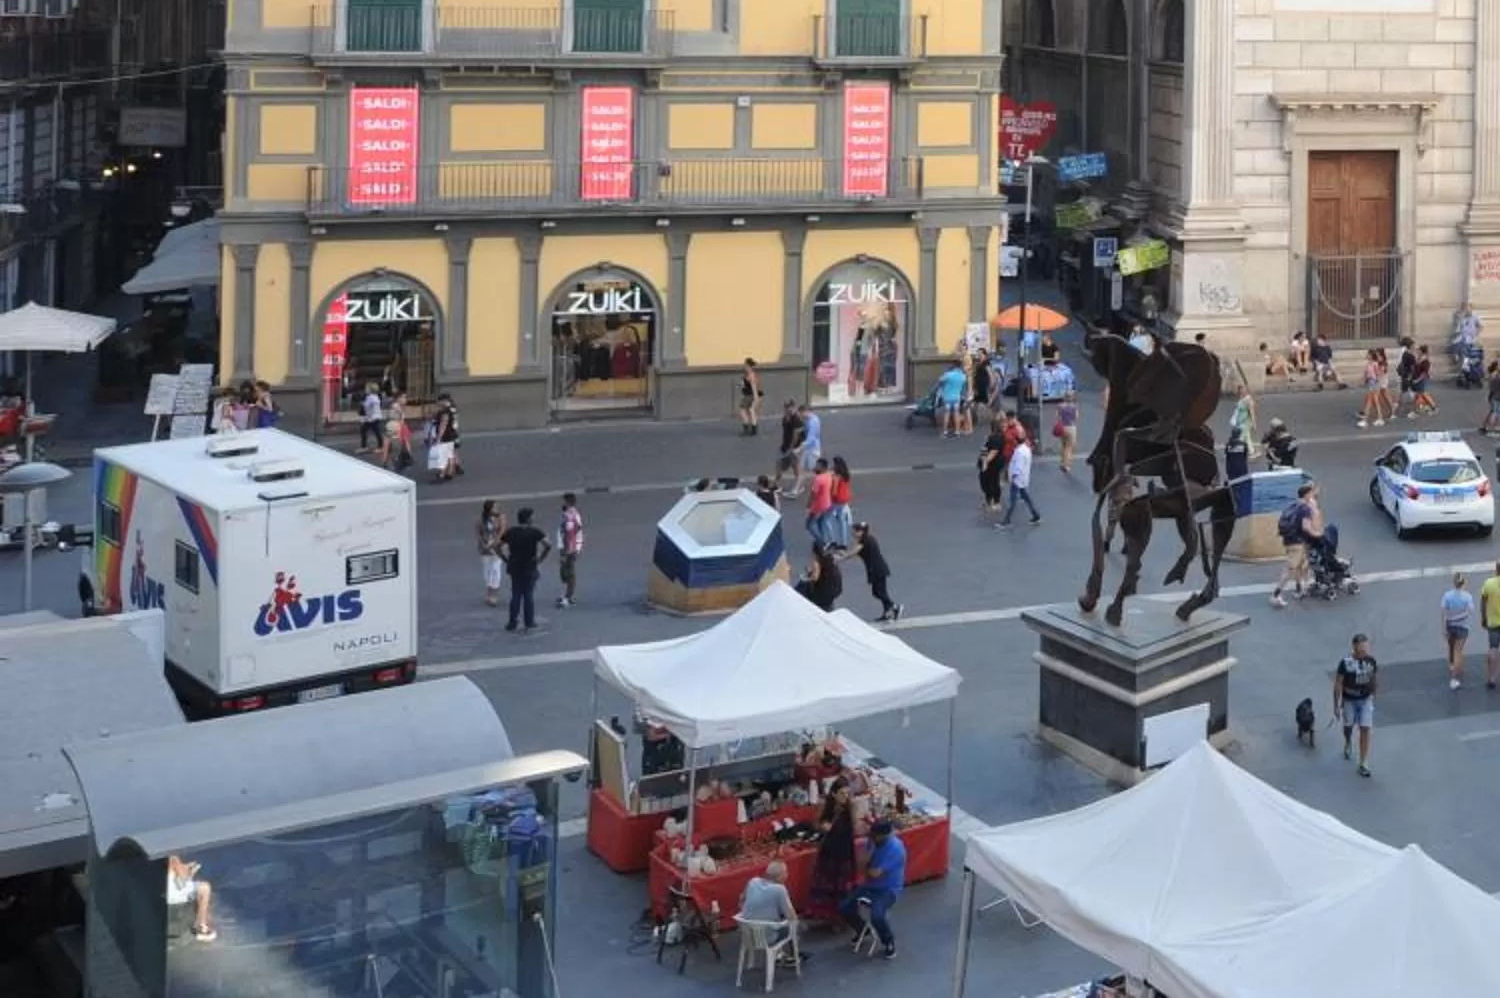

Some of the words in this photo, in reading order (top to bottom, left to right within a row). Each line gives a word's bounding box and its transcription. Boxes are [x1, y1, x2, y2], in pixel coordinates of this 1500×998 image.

[363, 97, 407, 109] SALDI
[591, 105, 625, 115] SALDI
[853, 105, 882, 113] SALDI
[363, 119, 405, 131] SALDI
[591, 121, 625, 131] SALDI
[852, 120, 882, 128] SALDI
[591, 138, 625, 147] SALDI
[851, 135, 882, 145] SALDI
[361, 140, 405, 152] SALDI
[359, 183, 403, 195] SALD
[253, 589, 364, 637] AVIS
[332, 632, 400, 652] NAPOLI
